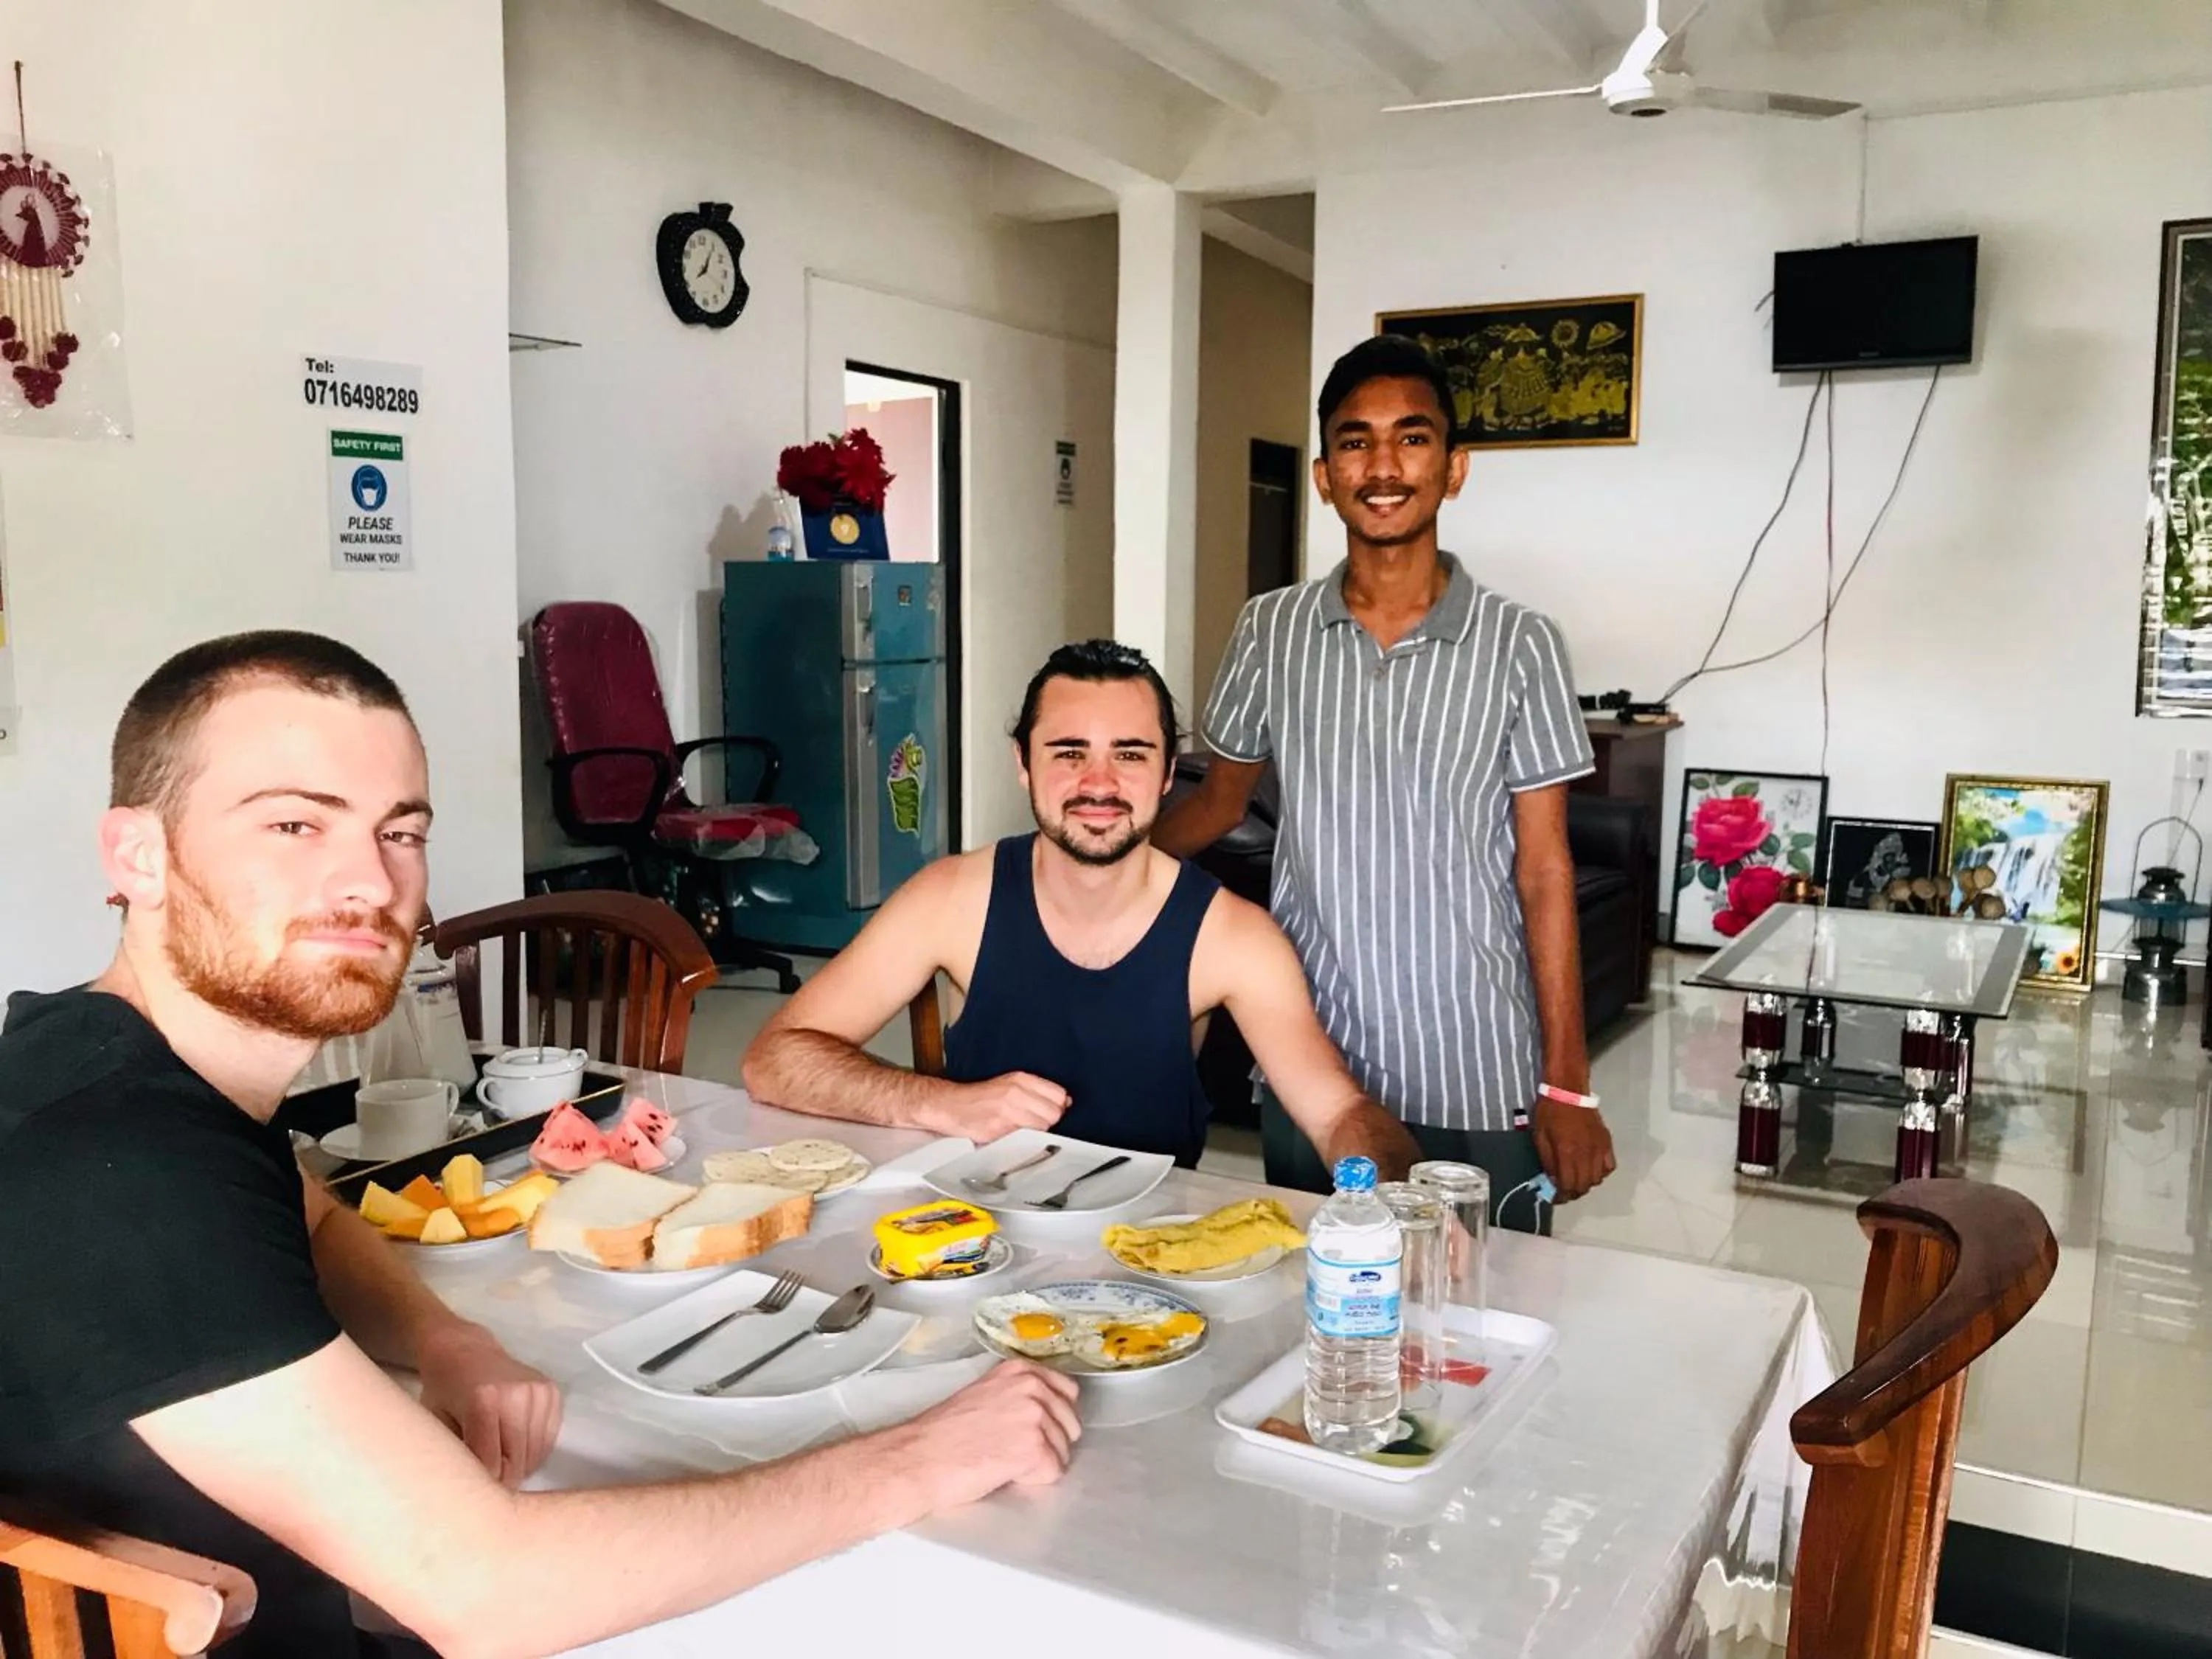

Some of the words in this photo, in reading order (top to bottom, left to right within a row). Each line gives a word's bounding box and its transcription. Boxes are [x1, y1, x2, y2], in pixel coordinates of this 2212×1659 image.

[305, 358, 334, 374] Tel:
[304, 378, 419, 414] 0716498289
[333, 438, 372, 451] SAFETY
[374, 441, 401, 453] FIRST
[348, 516, 393, 531] PLEASE
[340, 533, 366, 544] WEAR
[369, 534, 403, 545] MASKS
[344, 552, 376, 563] THANK
[379, 553, 400, 564] YOU!
